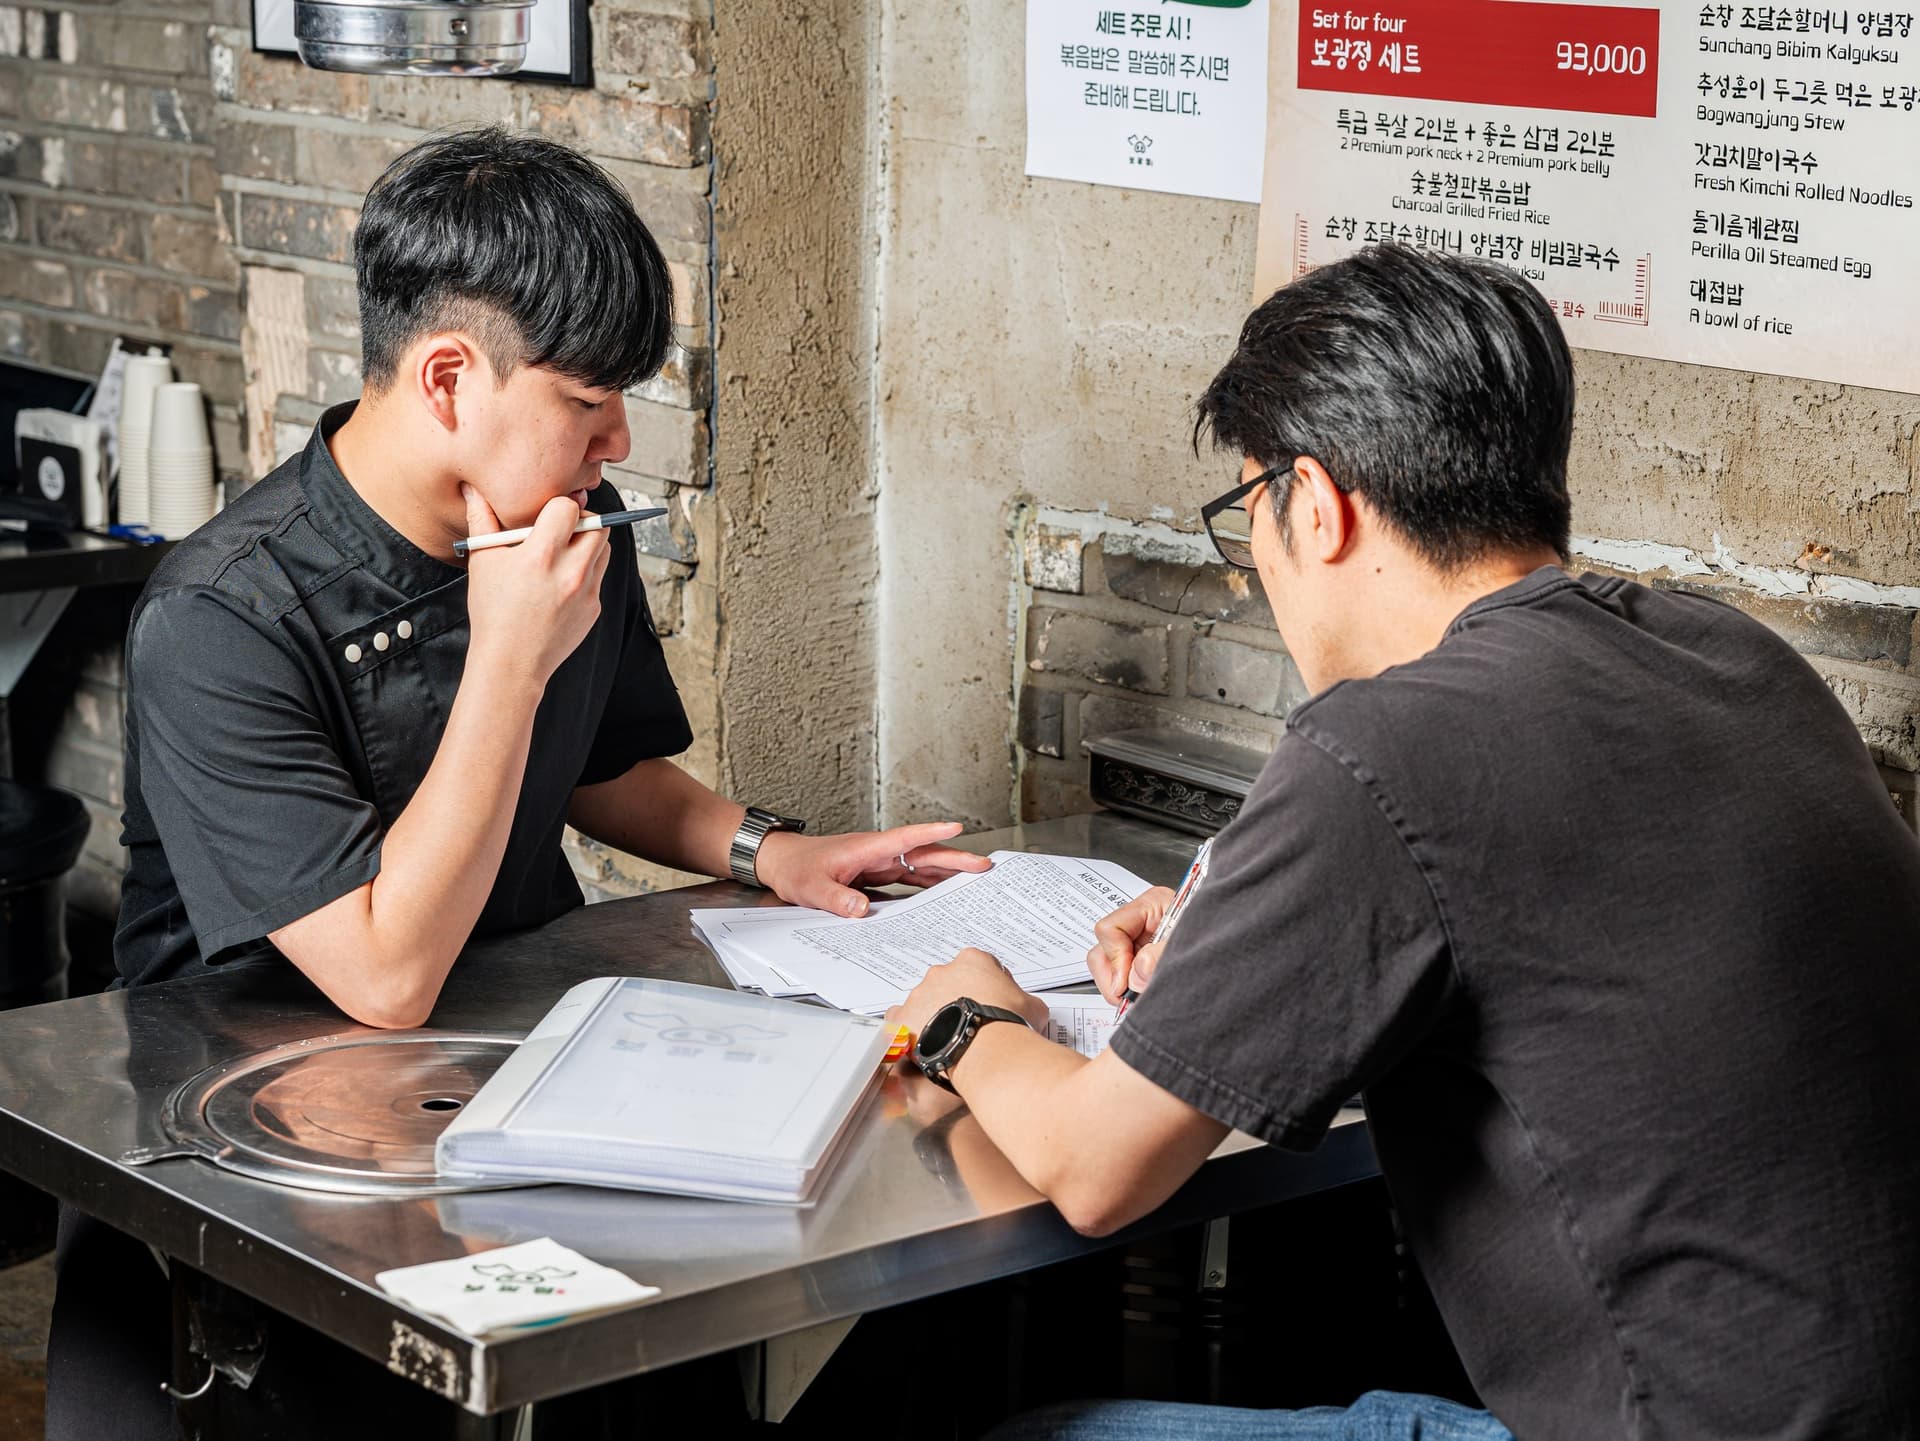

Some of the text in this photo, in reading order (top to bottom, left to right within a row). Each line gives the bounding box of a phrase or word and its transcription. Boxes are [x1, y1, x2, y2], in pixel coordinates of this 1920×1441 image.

[1096, 11, 1126, 35] 세트
[1130, 13, 1161, 39] 주문
[1312, 9, 1407, 33] Set for four
[1699, 3, 1914, 38] 순창 조달순할머니 양념장
[1061, 44, 1229, 81] 볶음밥은 말씀해 주시면
[1311, 38, 1422, 74] 보광정 세트
[1556, 41, 1647, 76] 93,000
[1699, 36, 1899, 64] Sunchang Bibim Kalguksu
[1084, 81, 1201, 116] 준비해 드립니다.
[1697, 72, 1920, 112] 추성훈이 두그릇 먹은 보광
[1336, 108, 1615, 157] 특급 목살 2인분 + 좋은 삼겹 2인분
[1697, 105, 1845, 131] Bogwangjung Stew
[1340, 137, 1611, 179] 2 Premium pork neck + 2 Premium pork belly
[1694, 143, 1818, 175] 갓김치말이국수
[1411, 169, 1531, 206] 숯불철판볶음밥
[1694, 173, 1913, 208] Fresh Kimchi Rolled Noodles
[1392, 196, 1551, 225] Charcoal Grilled Fried Rice
[1692, 210, 1799, 243] 들기름계란찜
[1325, 216, 1357, 241] 순창
[1470, 231, 1524, 261] 양념장
[1531, 239, 1620, 273] 비빔칼국수
[1691, 241, 1872, 279] Perilla Oil Steamed Egg
[1690, 278, 1744, 306] 대접밥
[1689, 308, 1793, 335] A bowl of rice
